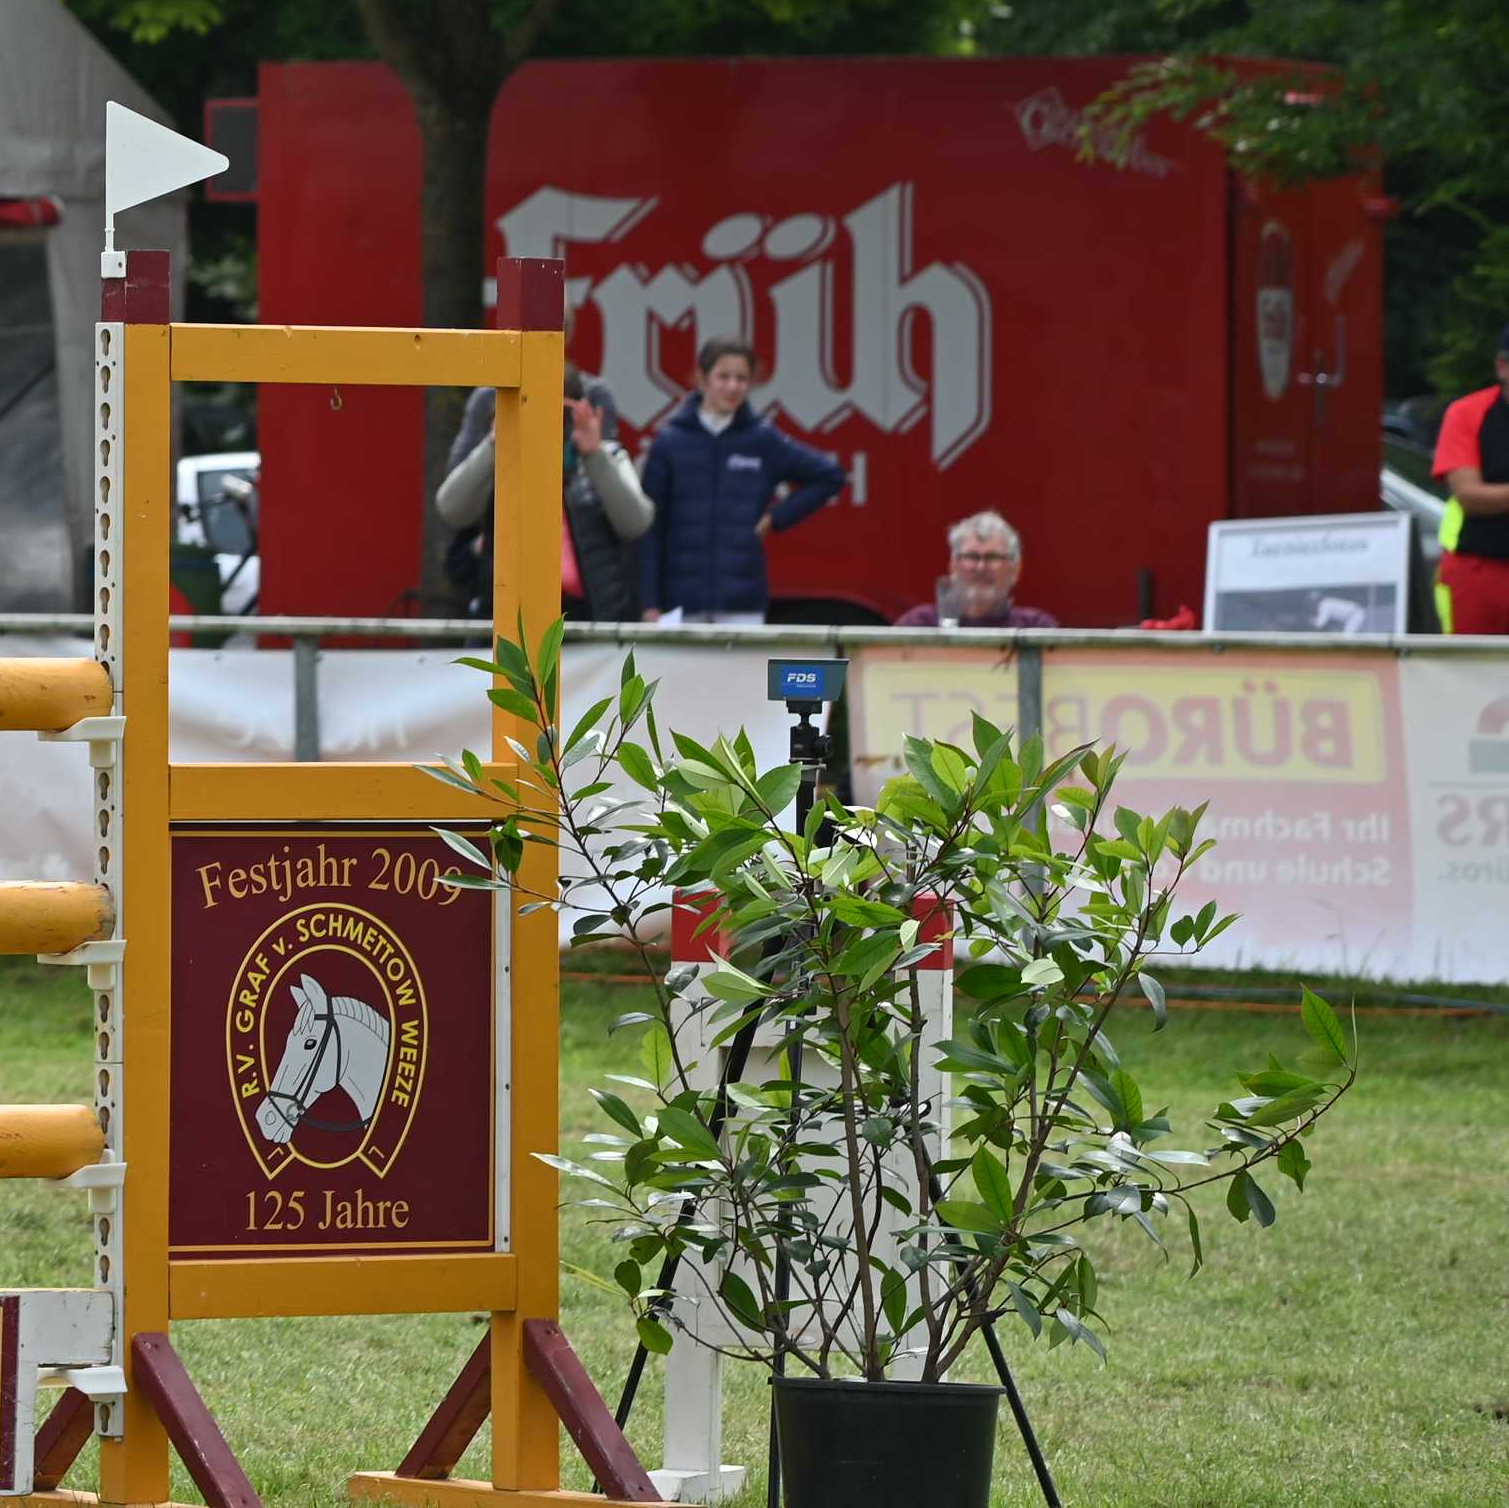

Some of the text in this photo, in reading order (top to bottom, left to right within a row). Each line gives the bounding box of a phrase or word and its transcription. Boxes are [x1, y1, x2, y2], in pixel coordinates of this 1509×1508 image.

[787, 673, 817, 683] FDS
[195, 844, 462, 909] Festjahr 2009
[235, 953, 271, 1033] GRAF
[272, 937, 293, 956] v.
[296, 913, 417, 1006] SCHMETTOW
[391, 1019, 420, 1108] WEEZE
[245, 1188, 410, 1230] 125 Jahre
